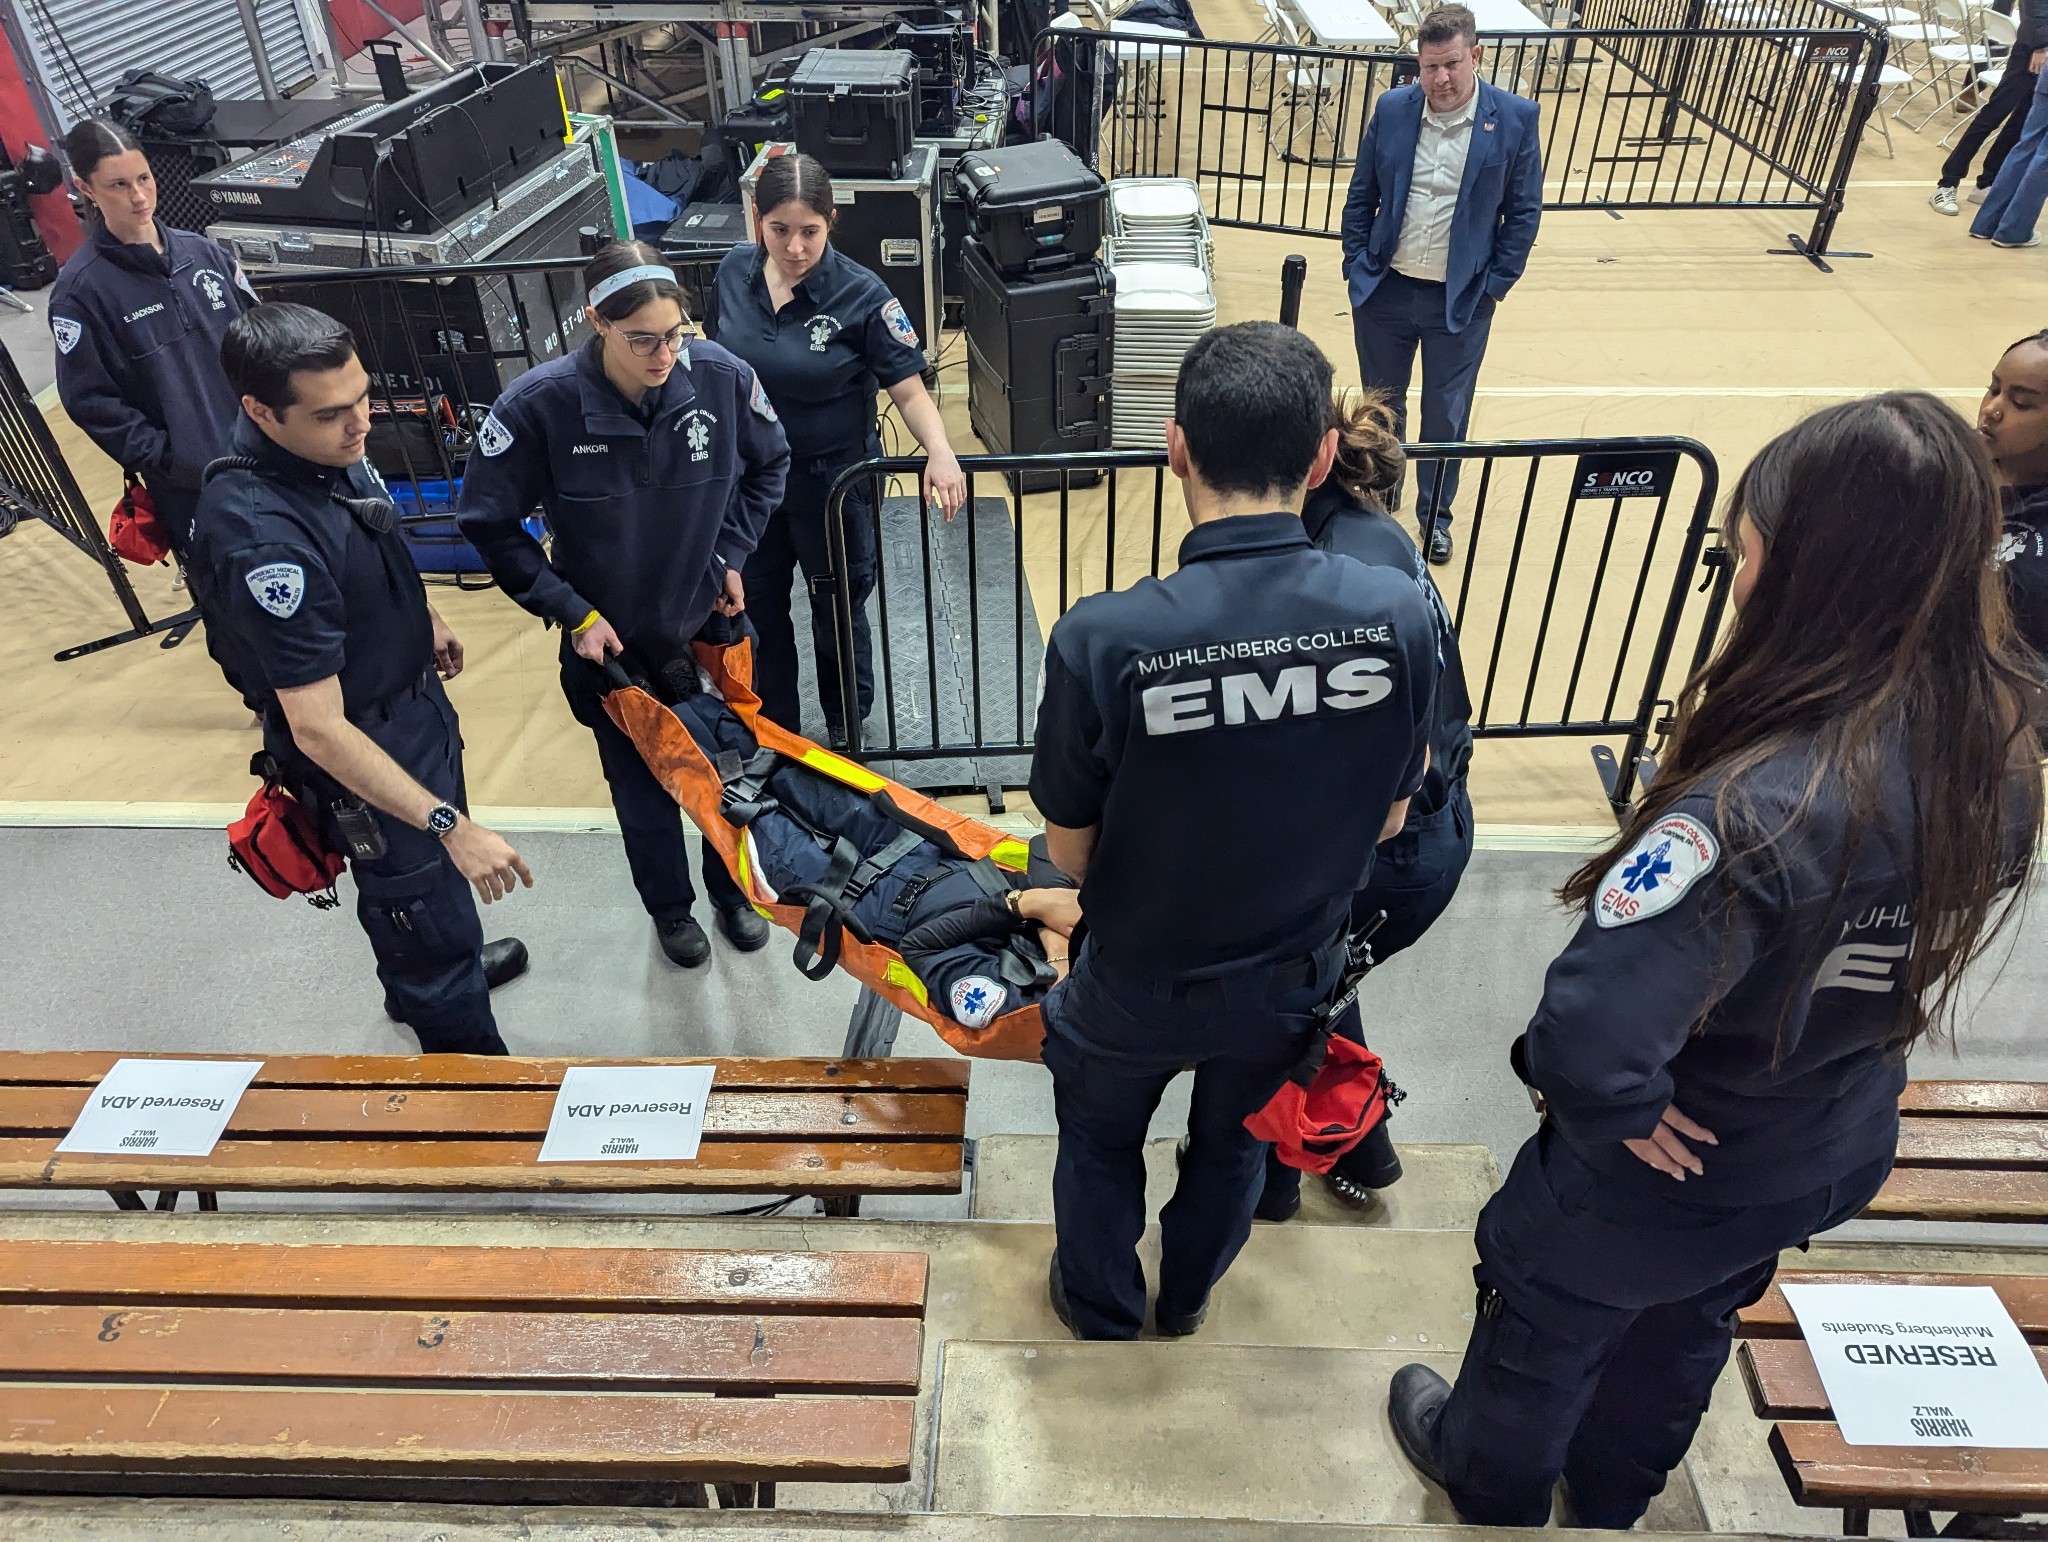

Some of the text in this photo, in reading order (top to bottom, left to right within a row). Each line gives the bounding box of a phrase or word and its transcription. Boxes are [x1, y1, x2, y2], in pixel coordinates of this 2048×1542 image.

[221, 191, 262, 205] YAMAHA
[132, 302, 164, 320] JACKSON
[212, 301, 226, 310] EMS
[544, 305, 586, 354] MOET-01
[810, 343, 826, 351] EMS
[572, 444, 609, 455] ANKORI
[691, 451, 709, 461] EMS
[2035, 532, 2043, 557] COLLEGE
[248, 567, 300, 583] EMERGENCY MEDICAL
[257, 573, 289, 583] TECHNICIAN
[1138, 625, 1391, 676] MUHLENBERG COLLEGE
[1142, 657, 1393, 736] EMS
[1687, 827, 1710, 861] COLLEGE
[1603, 887, 1640, 917] EMS
[954, 981, 971, 1006] EMS
[101, 1095, 224, 1112] Reserved ADA
[567, 1102, 692, 1118] Reserved ADA
[119, 1136, 159, 1148] HARRIS
[600, 1143, 640, 1155] HARRIS
[98, 1311, 130, 1342] 3
[1821, 1322, 1994, 1338] Muhlenberg Students
[1844, 1344, 1998, 1367] RESERVED
[1912, 1405, 1954, 1417] WALZ
[1910, 1417, 1974, 1438] HARRIS
